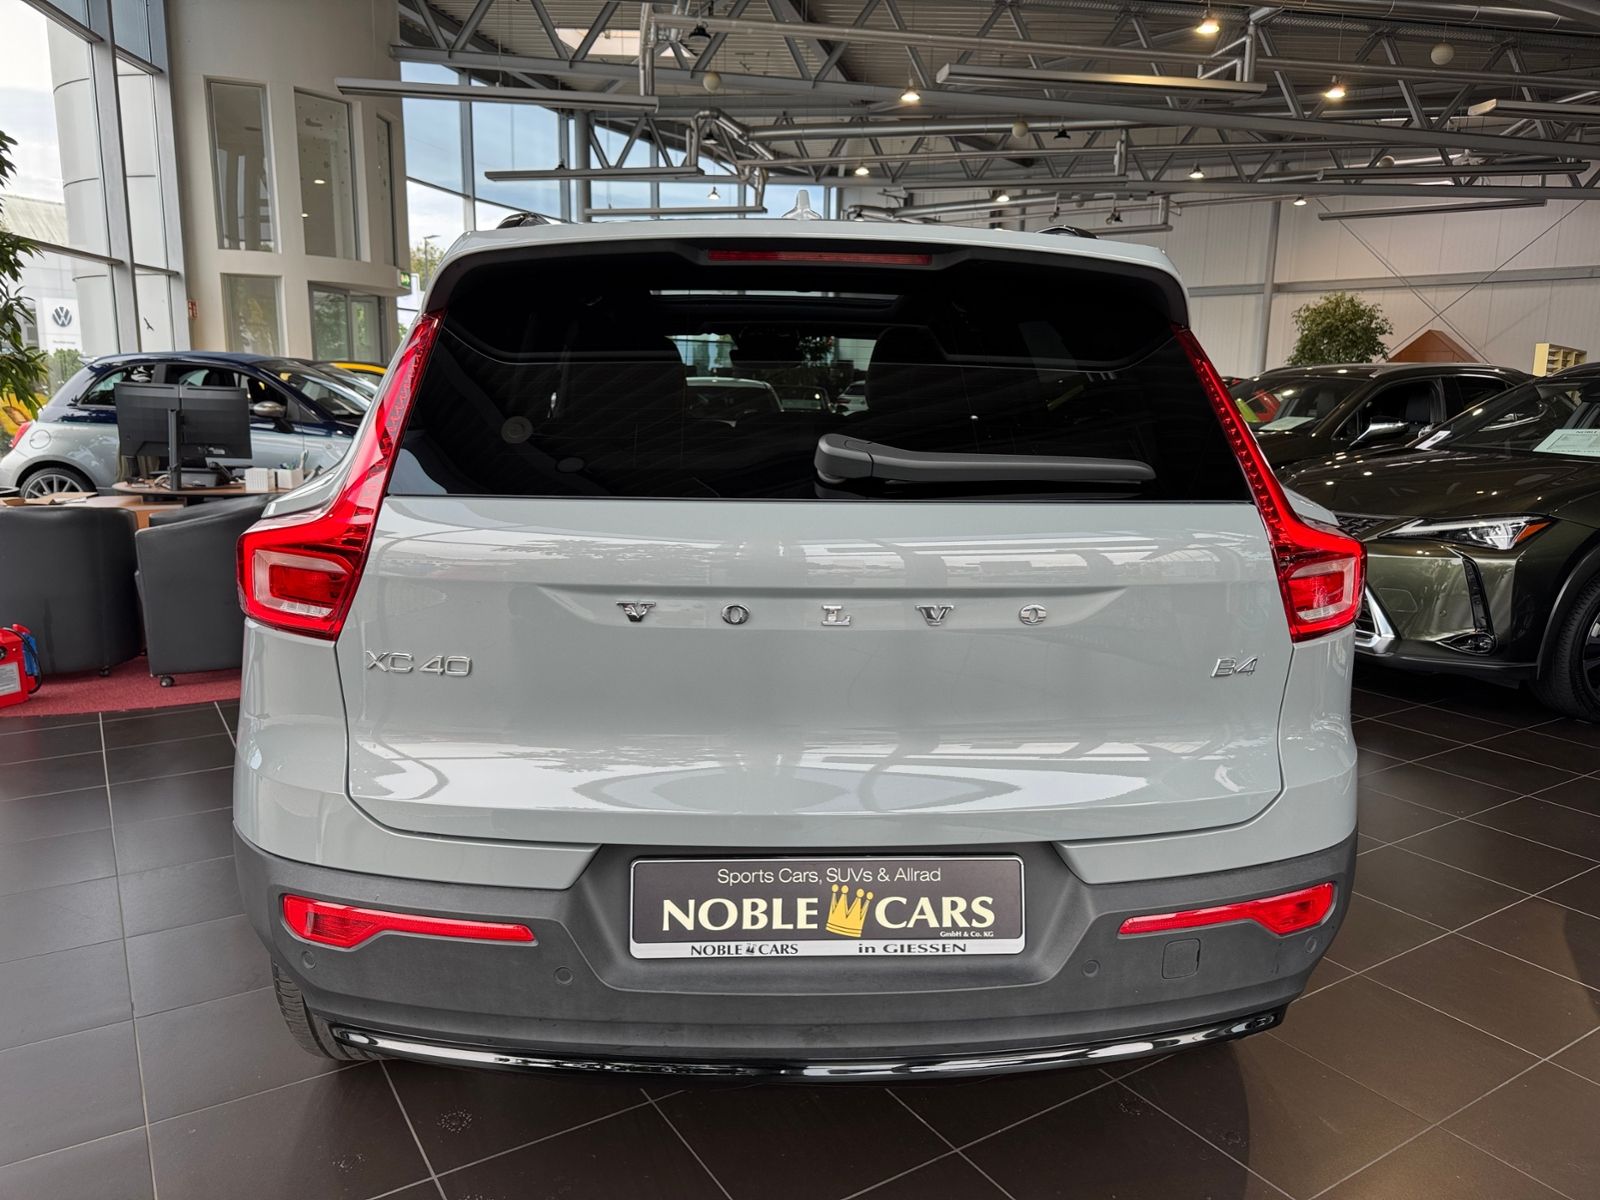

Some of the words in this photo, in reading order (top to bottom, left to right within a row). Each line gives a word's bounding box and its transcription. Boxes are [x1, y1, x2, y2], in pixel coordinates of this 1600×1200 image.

[616, 601, 1047, 627] VOLVO
[1210, 656, 1259, 678] B4
[717, 868, 774, 886] Sports
[778, 867, 822, 885] Cars,
[826, 867, 873, 882] SUVs
[877, 867, 891, 882] &
[894, 866, 942, 882] Allrad
[662, 897, 819, 931] NOBLE
[874, 896, 996, 929] CARS
[939, 930, 962, 938] GmbH
[970, 930, 983, 938] Co.
[983, 930, 994, 938] KG
[690, 943, 743, 956] NOBLE
[758, 943, 799, 955] CARS
[858, 942, 876, 954] in
[883, 943, 967, 954] GIESSEN
